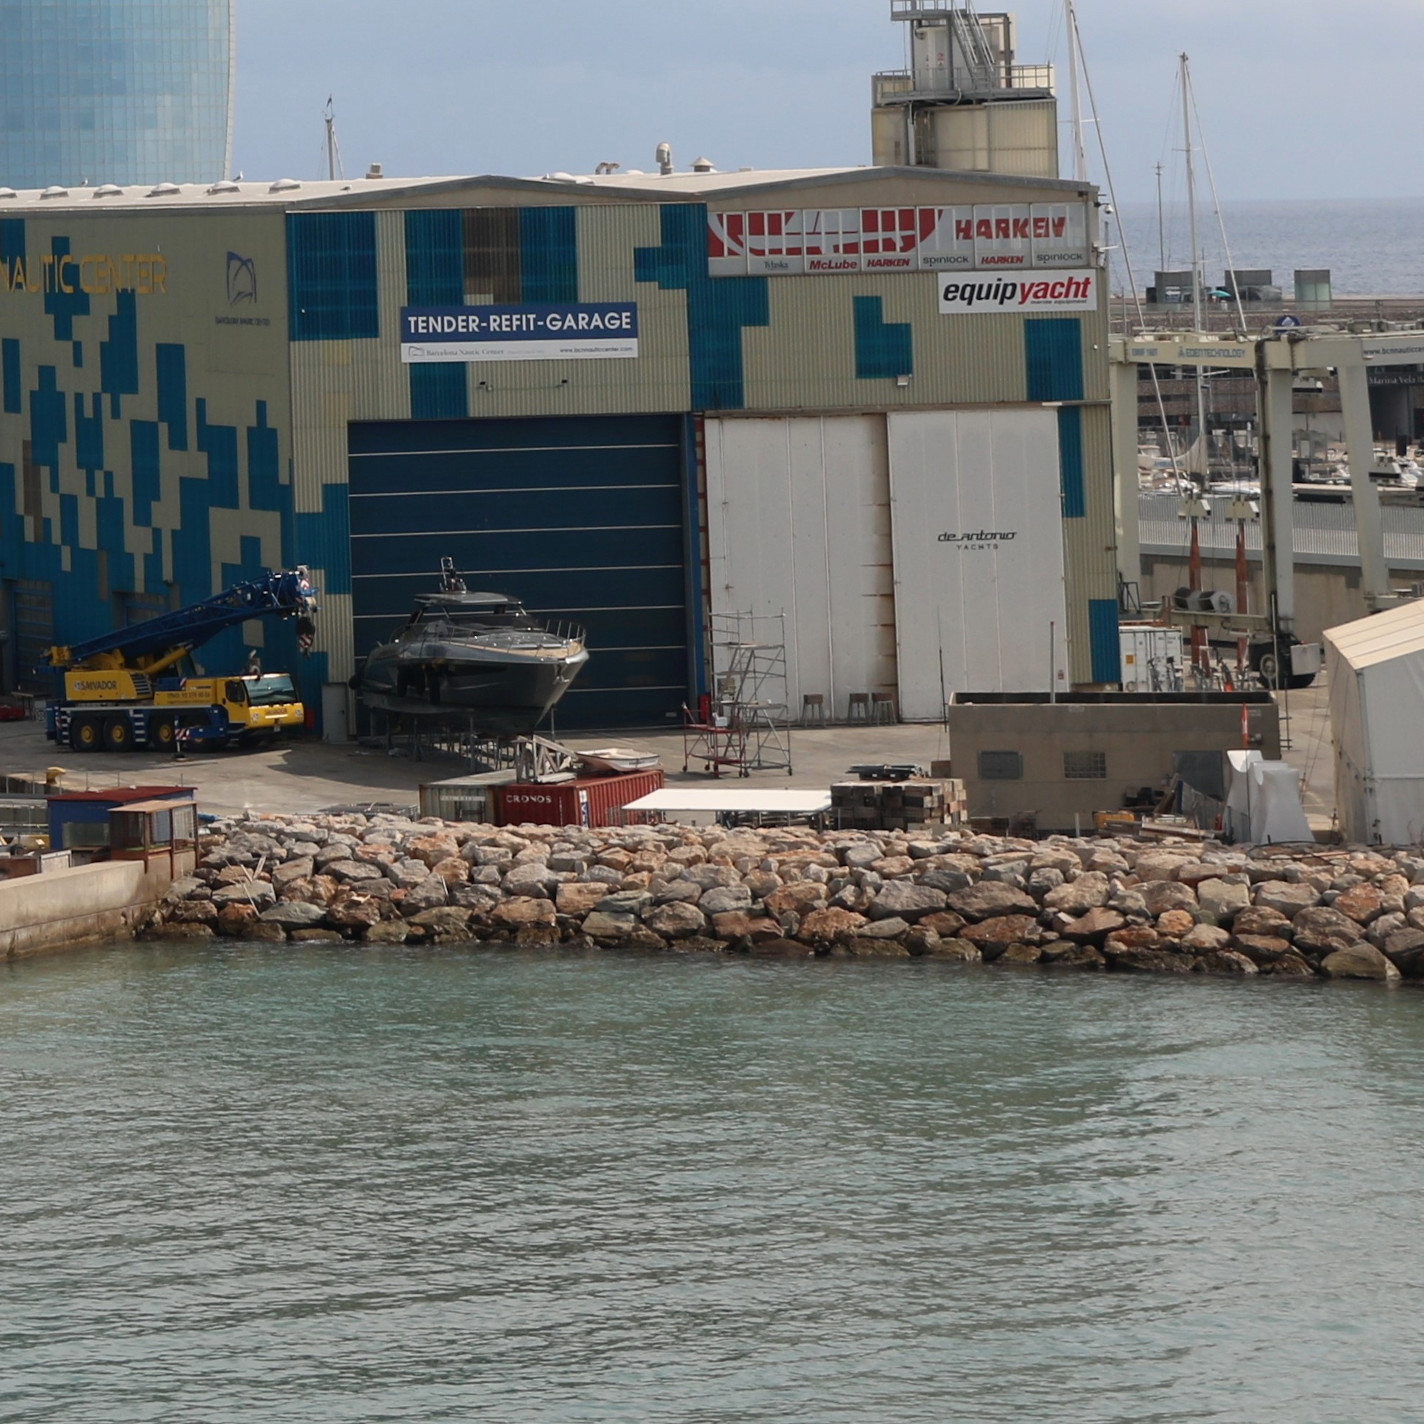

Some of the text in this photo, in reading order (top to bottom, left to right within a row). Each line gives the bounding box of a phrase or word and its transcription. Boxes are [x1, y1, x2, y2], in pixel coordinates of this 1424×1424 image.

[956, 216, 1066, 241] HARKEN
[867, 258, 911, 268] HARKEN
[922, 255, 970, 267] spinlock
[980, 255, 1025, 265] HARKEN
[1036, 252, 1084, 264] spinlock
[809, 259, 858, 271] McLube
[79, 253, 168, 295] CENTER
[942, 276, 1092, 306] equipyacht
[408, 312, 631, 334] TENDER-REFIT-GARAGE
[426, 348, 458, 356] Barcelona
[1368, 377, 1397, 385] Marina
[81, 680, 117, 691] SALVADOR
[506, 795, 552, 803] CRONOS
